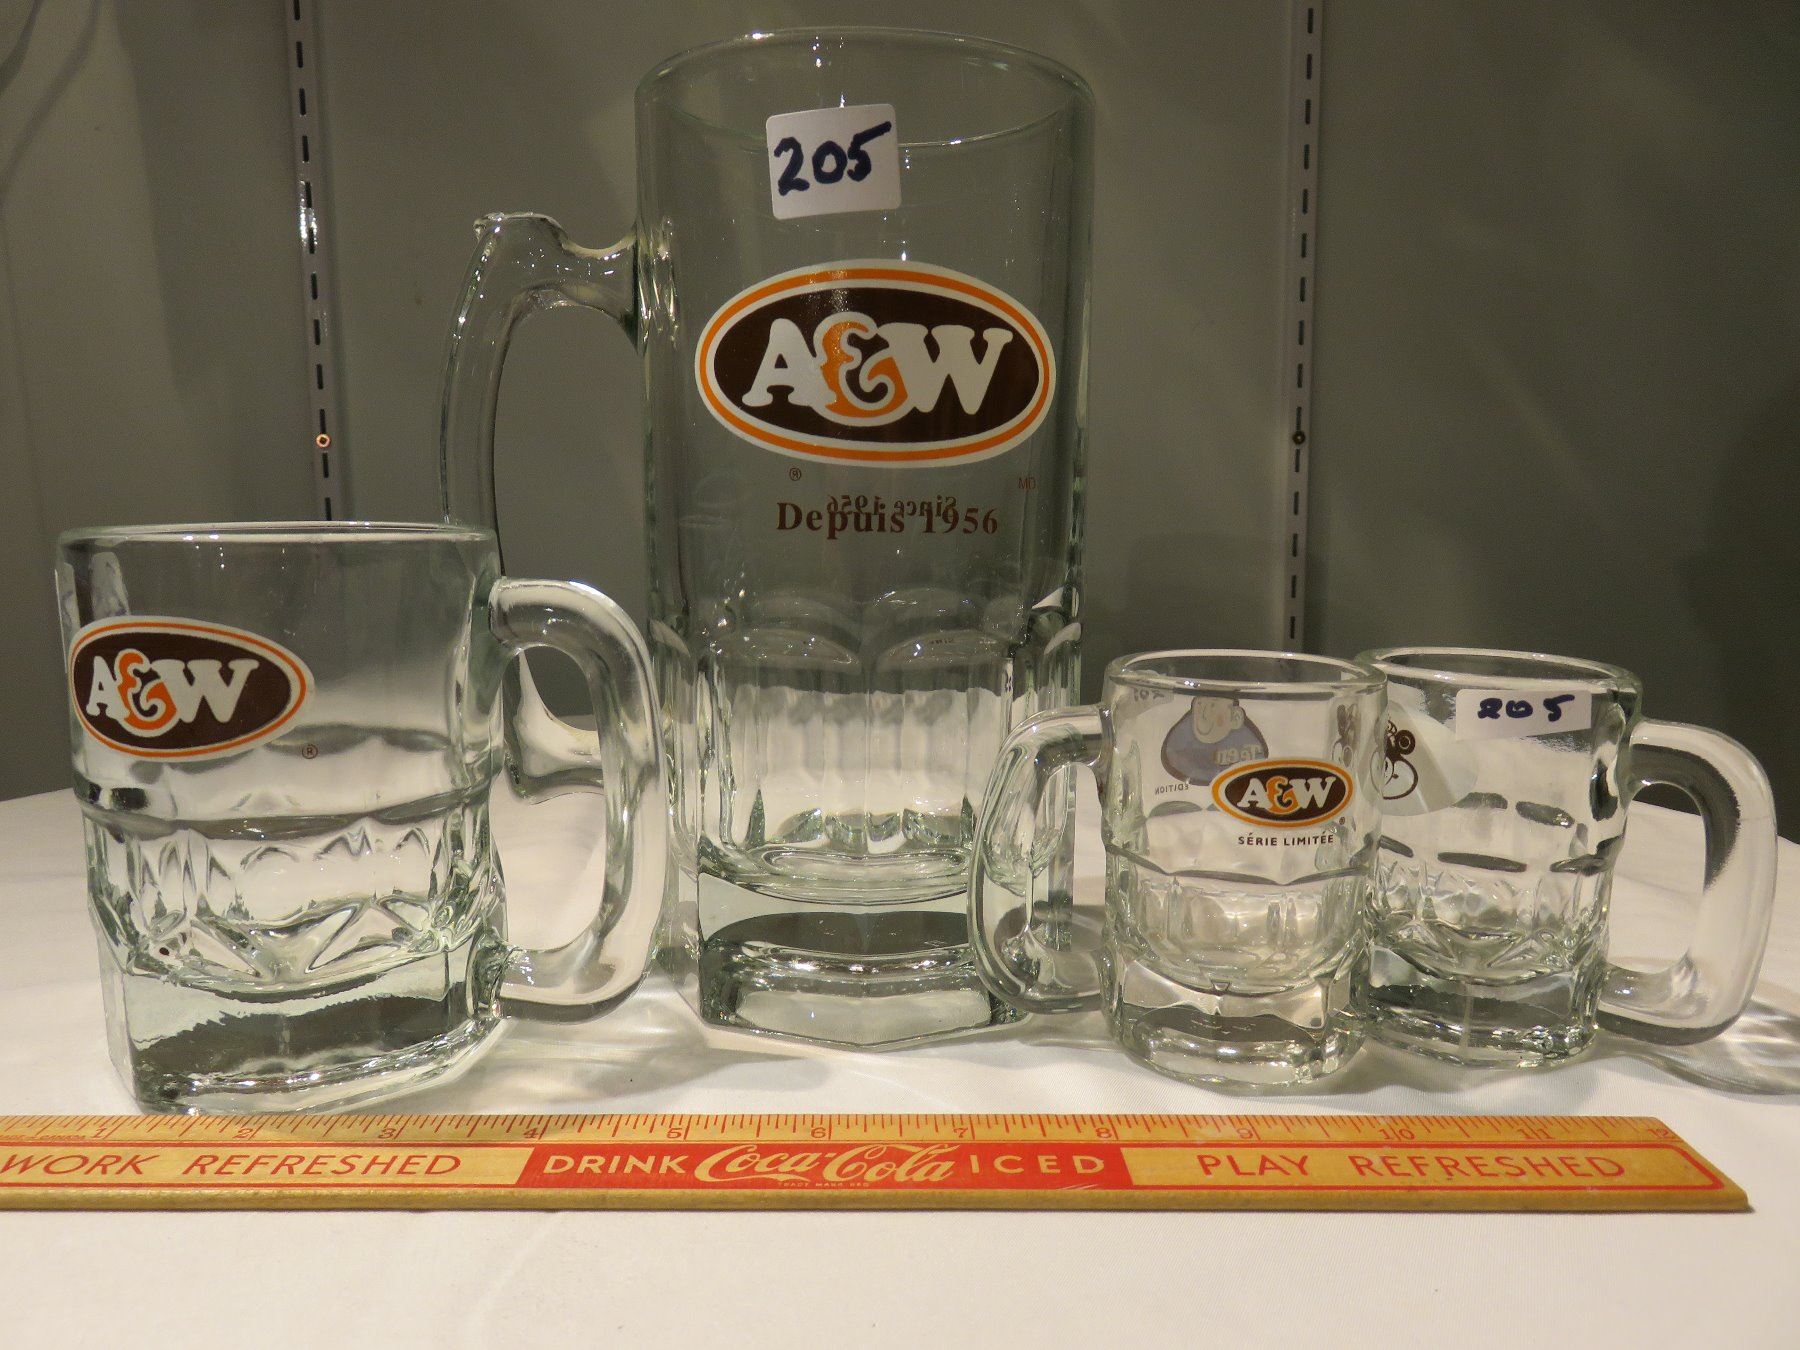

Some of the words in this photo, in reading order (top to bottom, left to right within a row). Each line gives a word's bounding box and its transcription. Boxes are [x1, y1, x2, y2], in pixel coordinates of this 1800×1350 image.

[774, 120, 892, 197] 205
[742, 312, 1014, 427] A&W
[776, 502, 905, 540] Depuis
[921, 506, 998, 534] 1956
[86, 648, 260, 738] A&W
[1477, 694, 1576, 722] 205
[1236, 775, 1337, 815] A&W
[1238, 832, 1278, 847] SÉRIE
[1284, 831, 1334, 846] LIMITÉE
[91, 1127, 107, 1138] 1
[233, 1128, 253, 1139] 2
[378, 1128, 396, 1139] 3
[523, 1127, 539, 1139] 4
[666, 1127, 683, 1139] 5
[810, 1127, 827, 1139] 6
[953, 1127, 968, 1139] 7
[1095, 1127, 1112, 1139] 8
[1236, 1128, 1253, 1139] 9
[0, 1153, 160, 1175] WORK
[182, 1154, 462, 1175] REFRESHED
[543, 1155, 689, 1174] DRINK
[969, 1154, 1105, 1174] ICED
[1197, 1154, 1309, 1176] PLAY
[1348, 1156, 1625, 1177] REFRESHED
